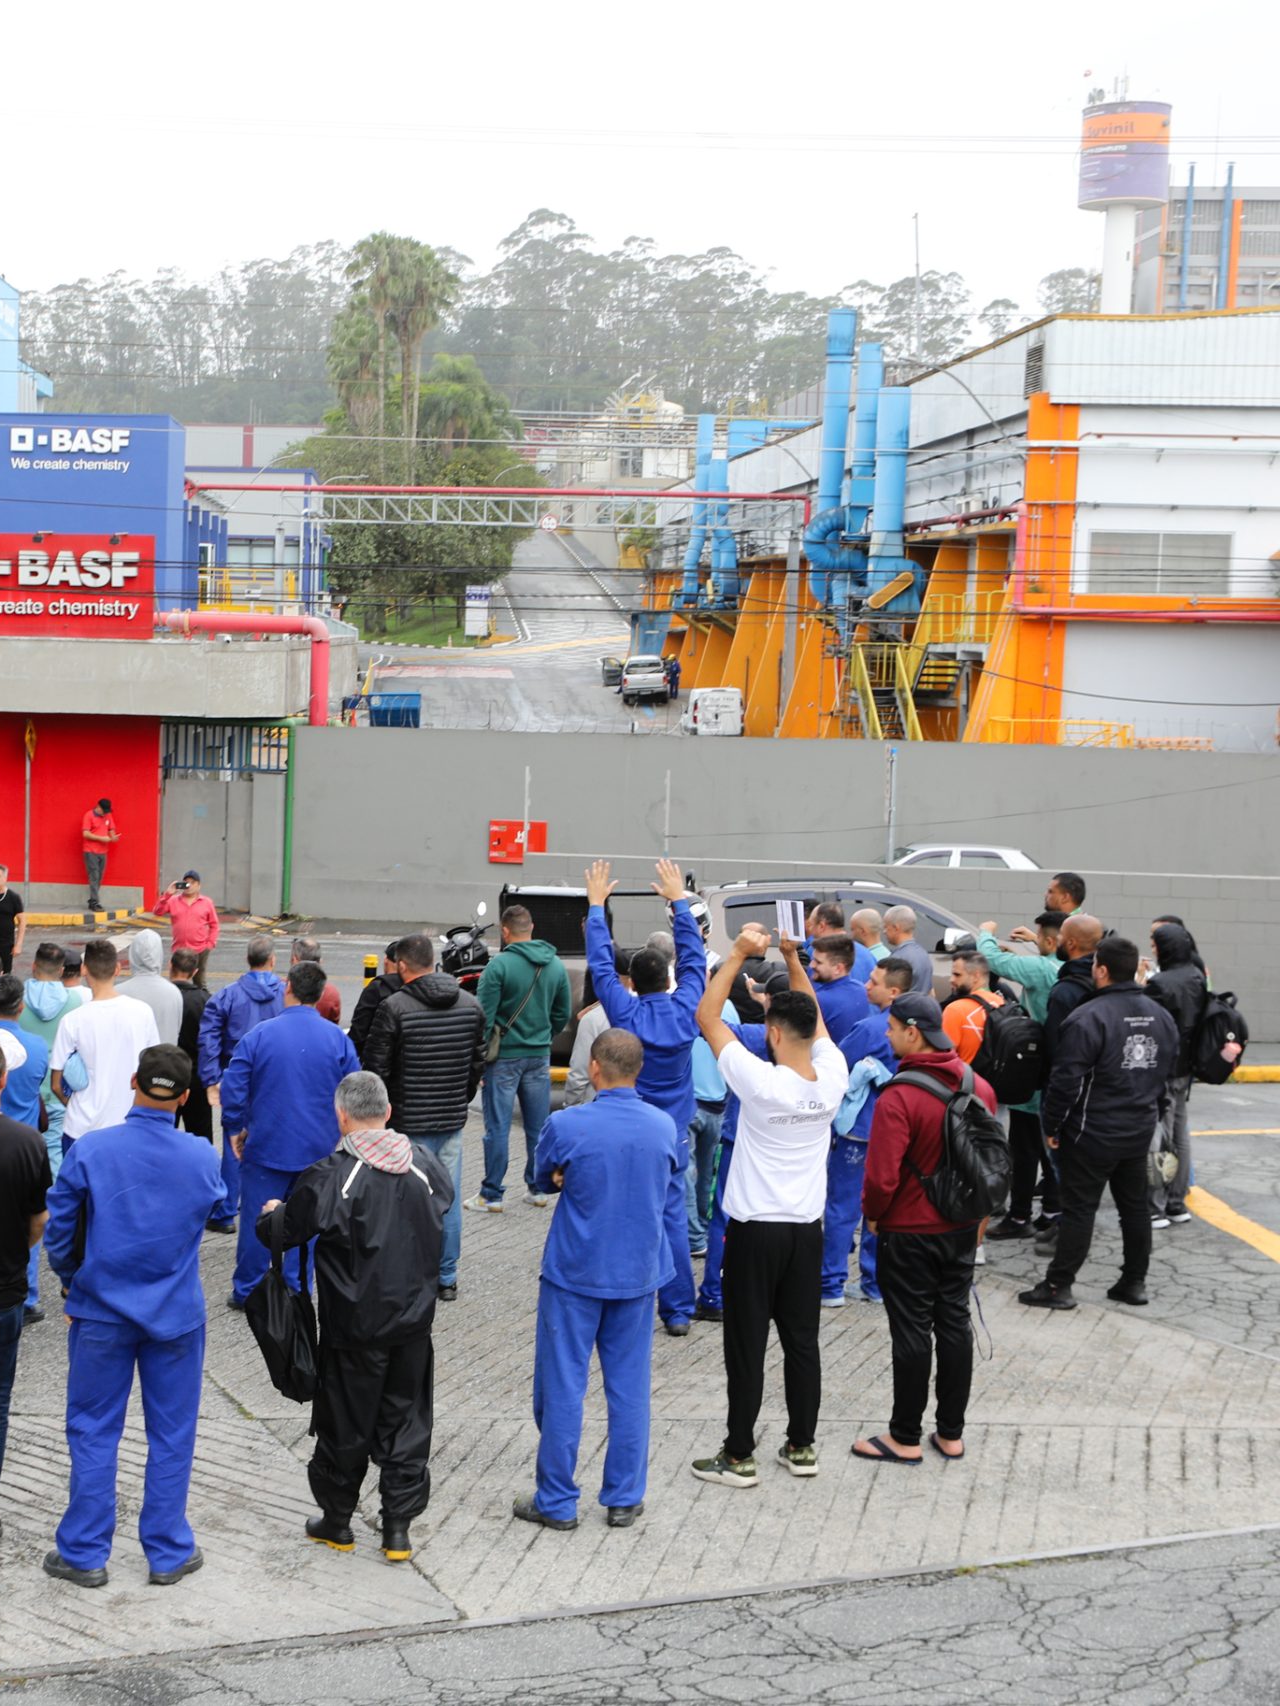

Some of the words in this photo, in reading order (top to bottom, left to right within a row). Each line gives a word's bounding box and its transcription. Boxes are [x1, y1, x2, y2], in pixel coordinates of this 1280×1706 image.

[51, 428, 130, 454] BASF
[10, 457, 30, 470] We
[32, 458, 69, 470] create
[72, 458, 130, 474] chemistry
[18, 550, 140, 588] BASF
[48, 598, 140, 620] chemistry
